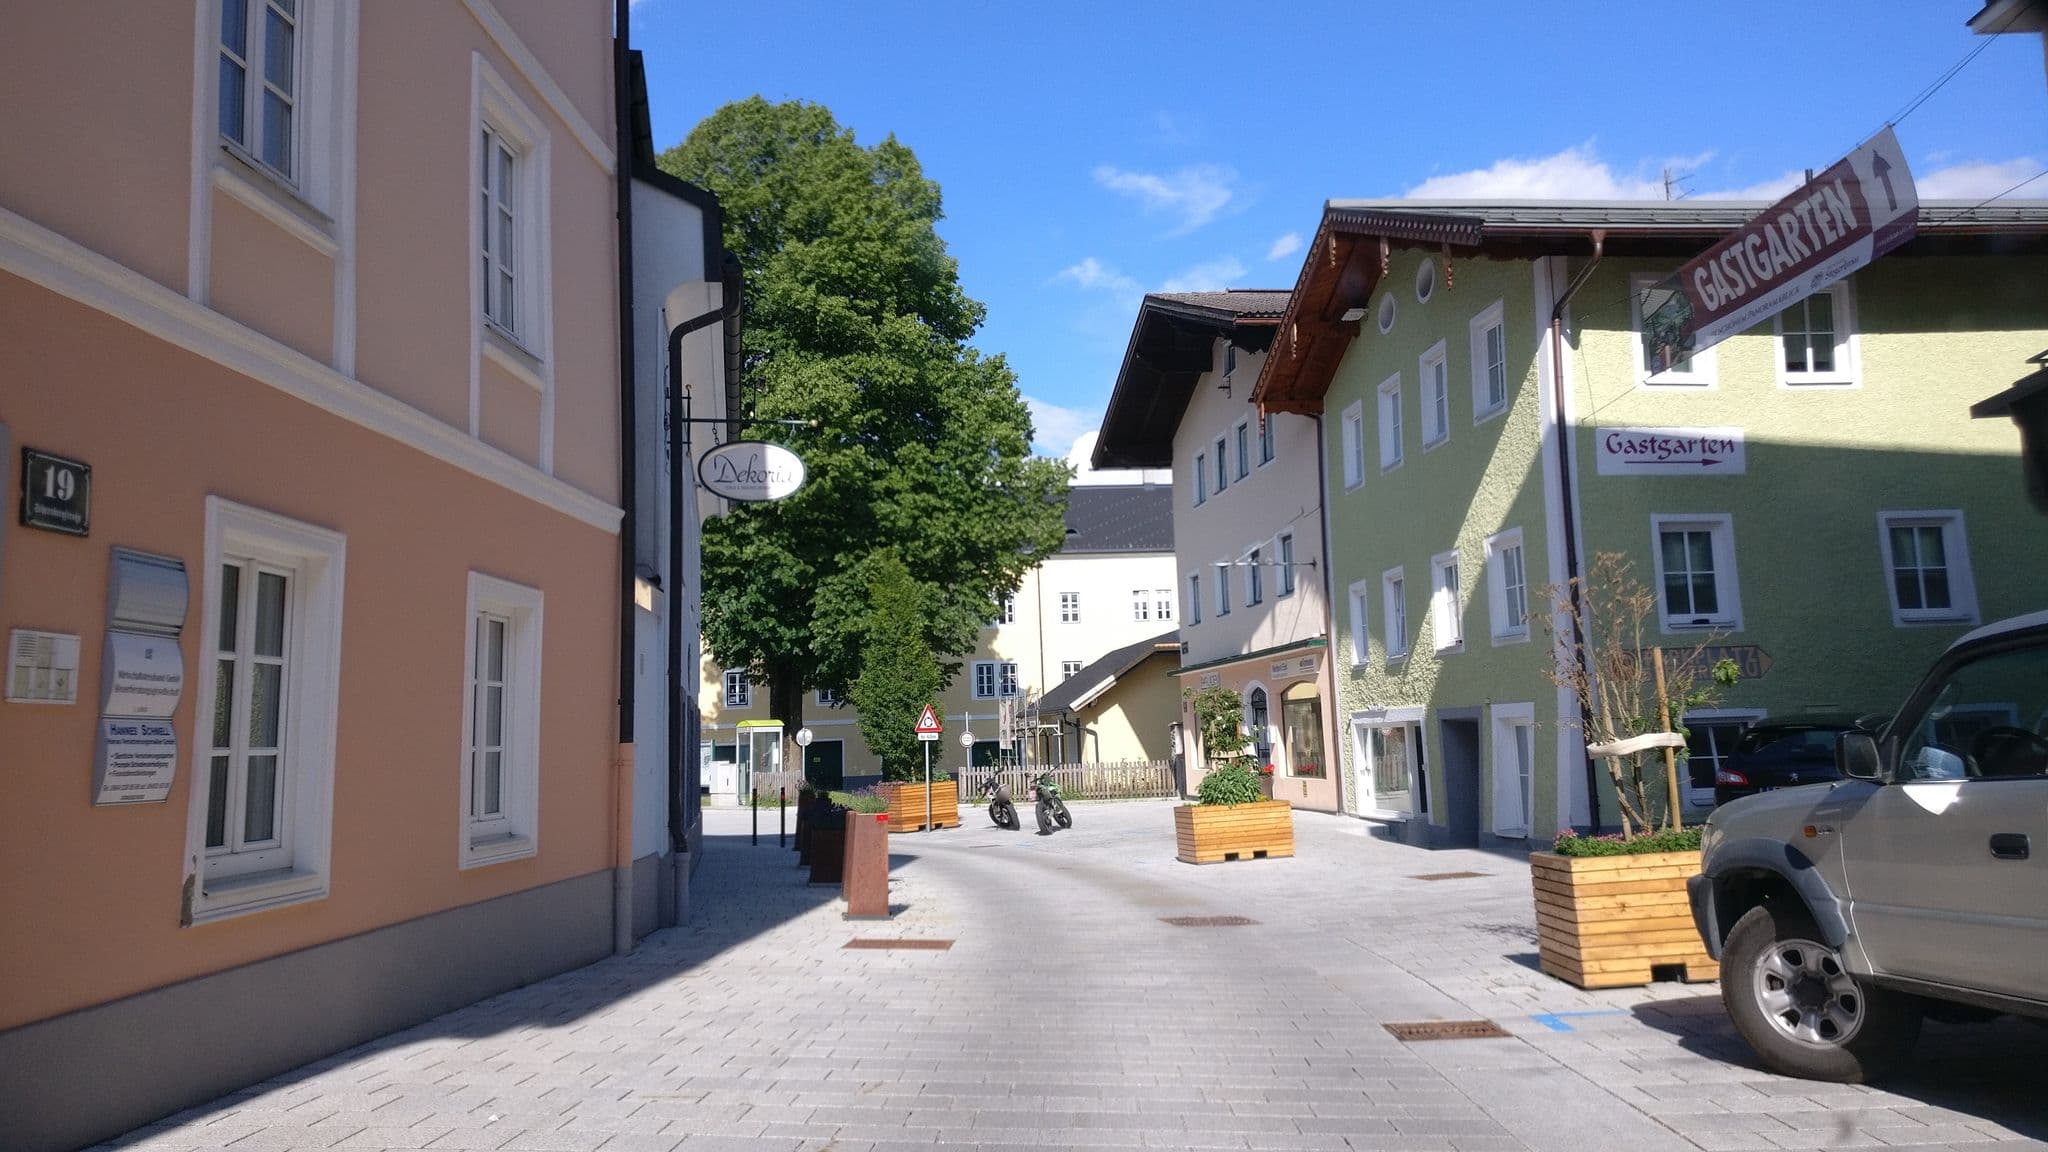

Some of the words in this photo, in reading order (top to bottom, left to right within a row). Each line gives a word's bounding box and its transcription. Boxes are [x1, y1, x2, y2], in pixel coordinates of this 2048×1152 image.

[1694, 178, 1858, 312] GASTGARTEN
[1606, 433, 1735, 460] Gastgarten
[44, 465, 75, 501] 19
